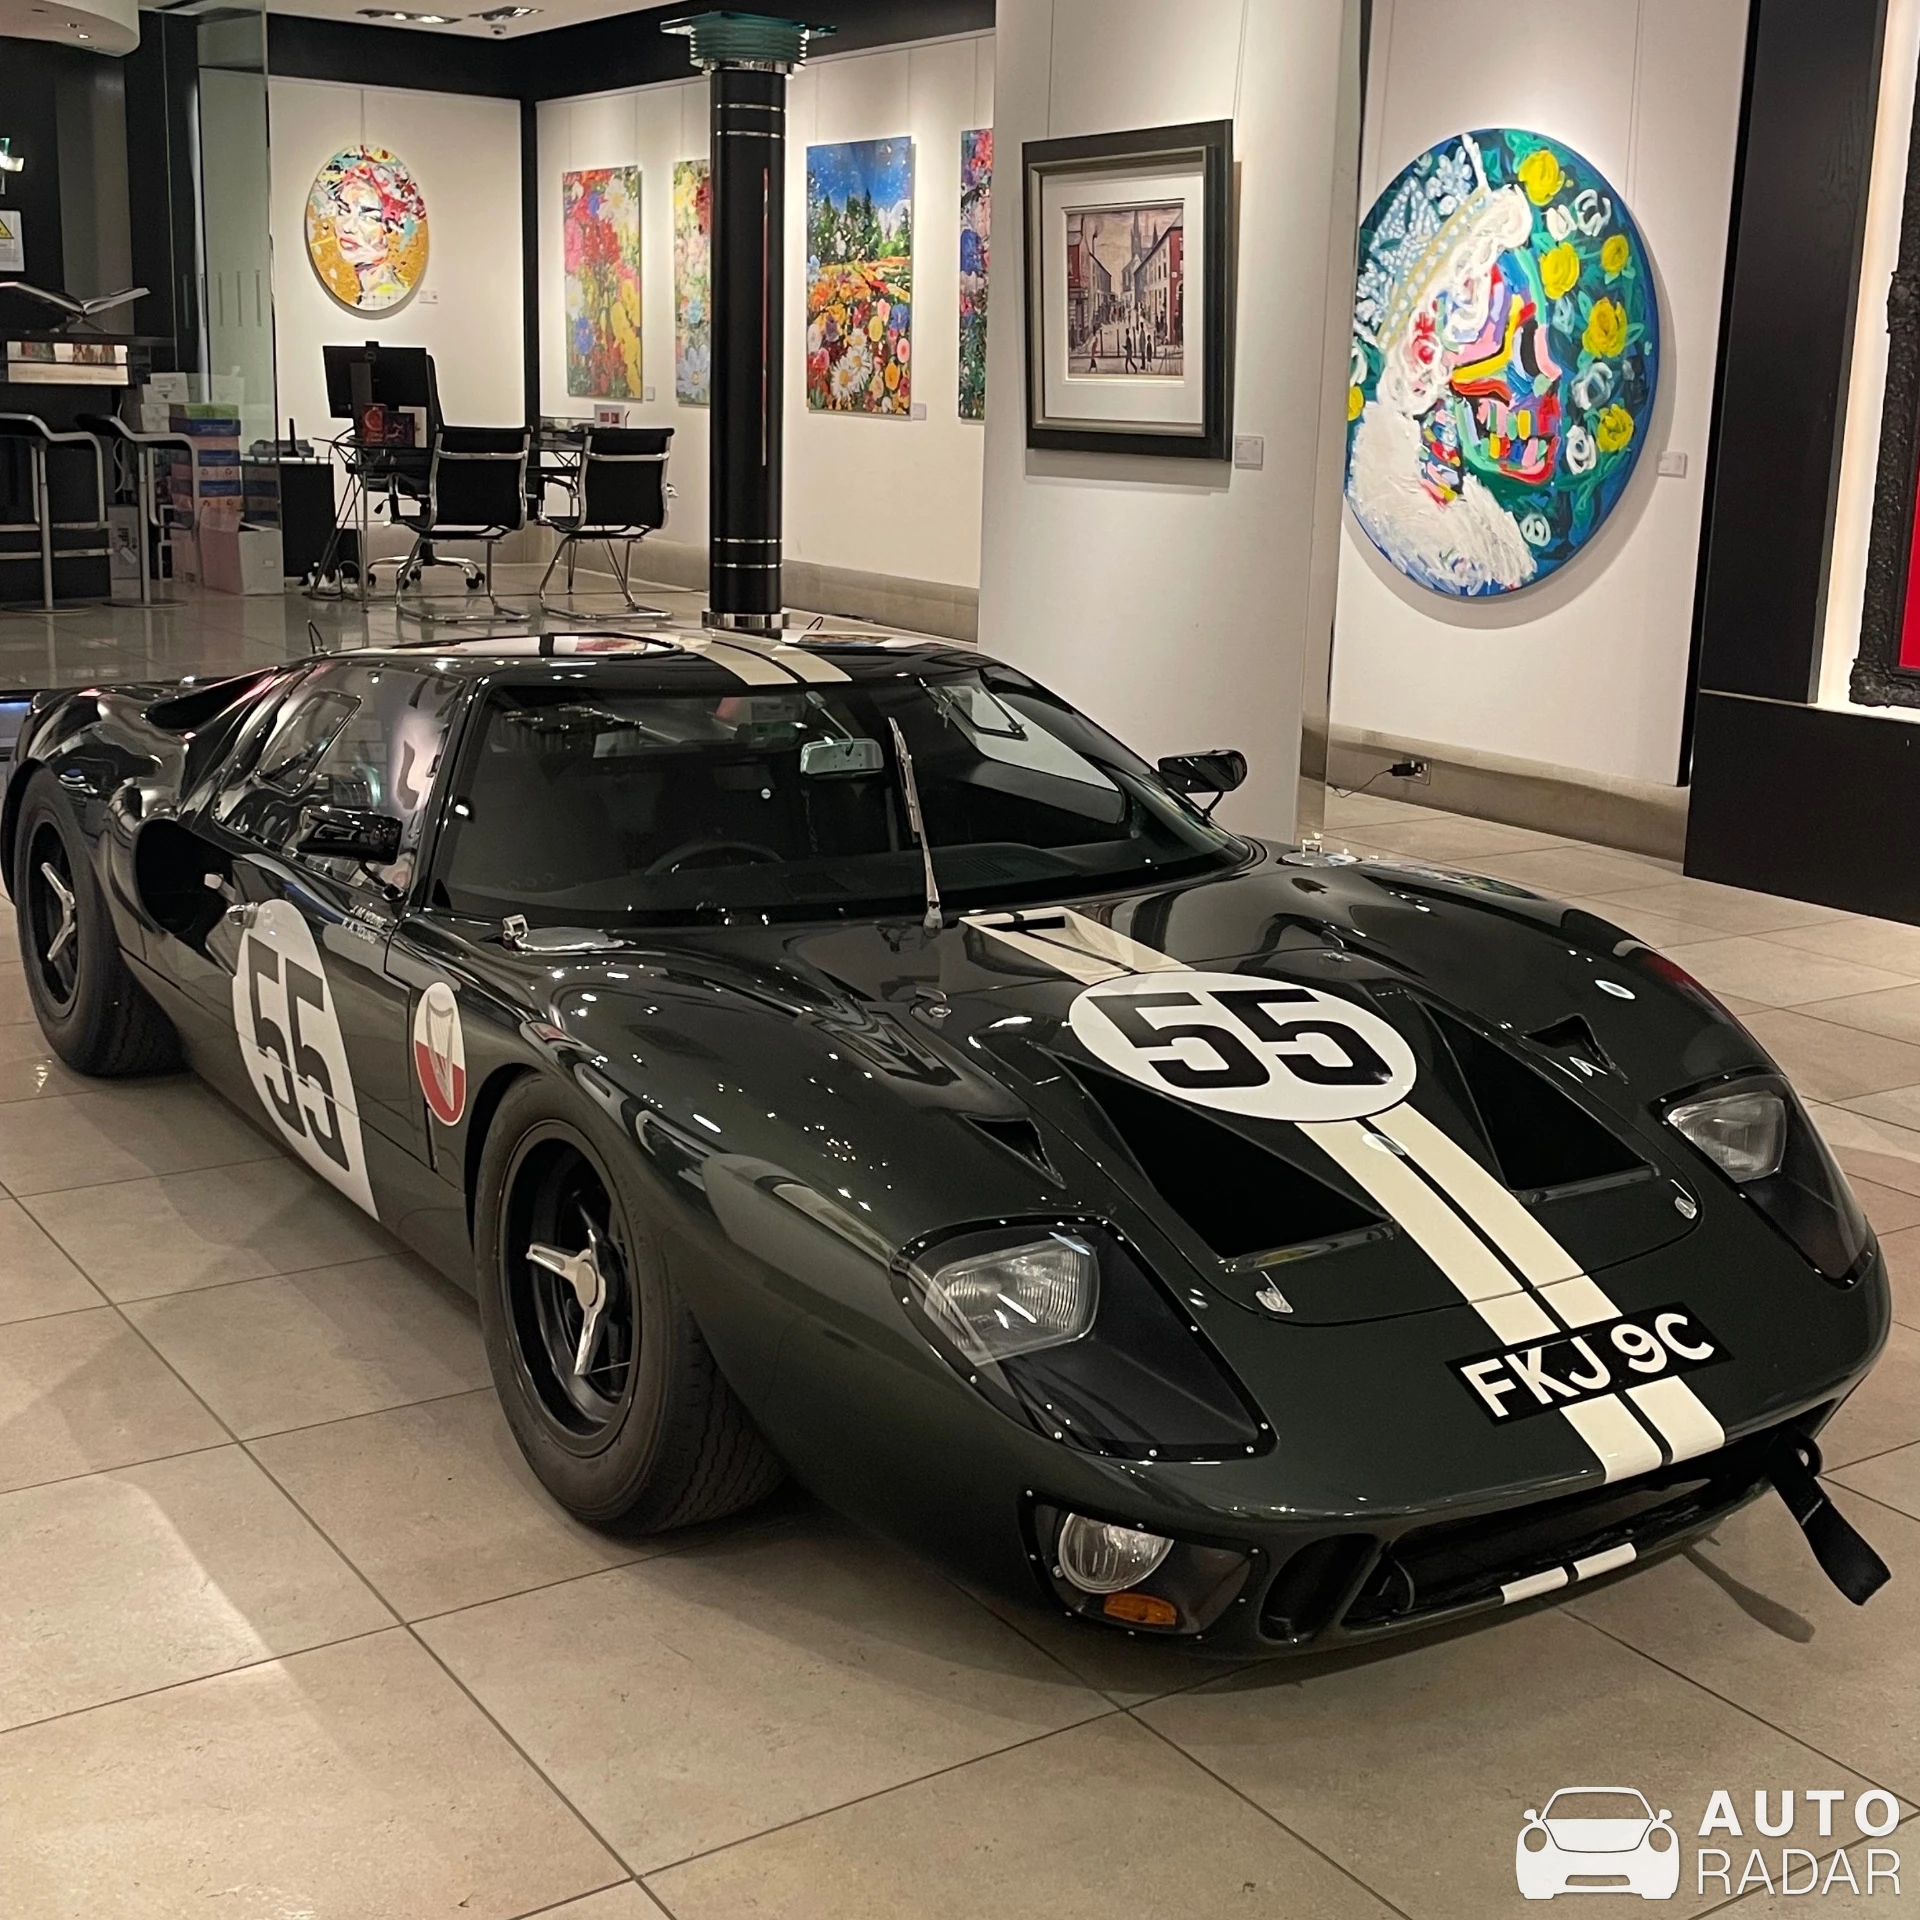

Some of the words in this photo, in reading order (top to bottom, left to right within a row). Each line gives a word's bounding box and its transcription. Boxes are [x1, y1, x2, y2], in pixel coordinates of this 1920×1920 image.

[247, 934, 350, 1172] 55
[1086, 988, 1394, 1090] 55
[1460, 1335, 1611, 1418] FKJ
[1610, 1312, 1715, 1374] 9C
